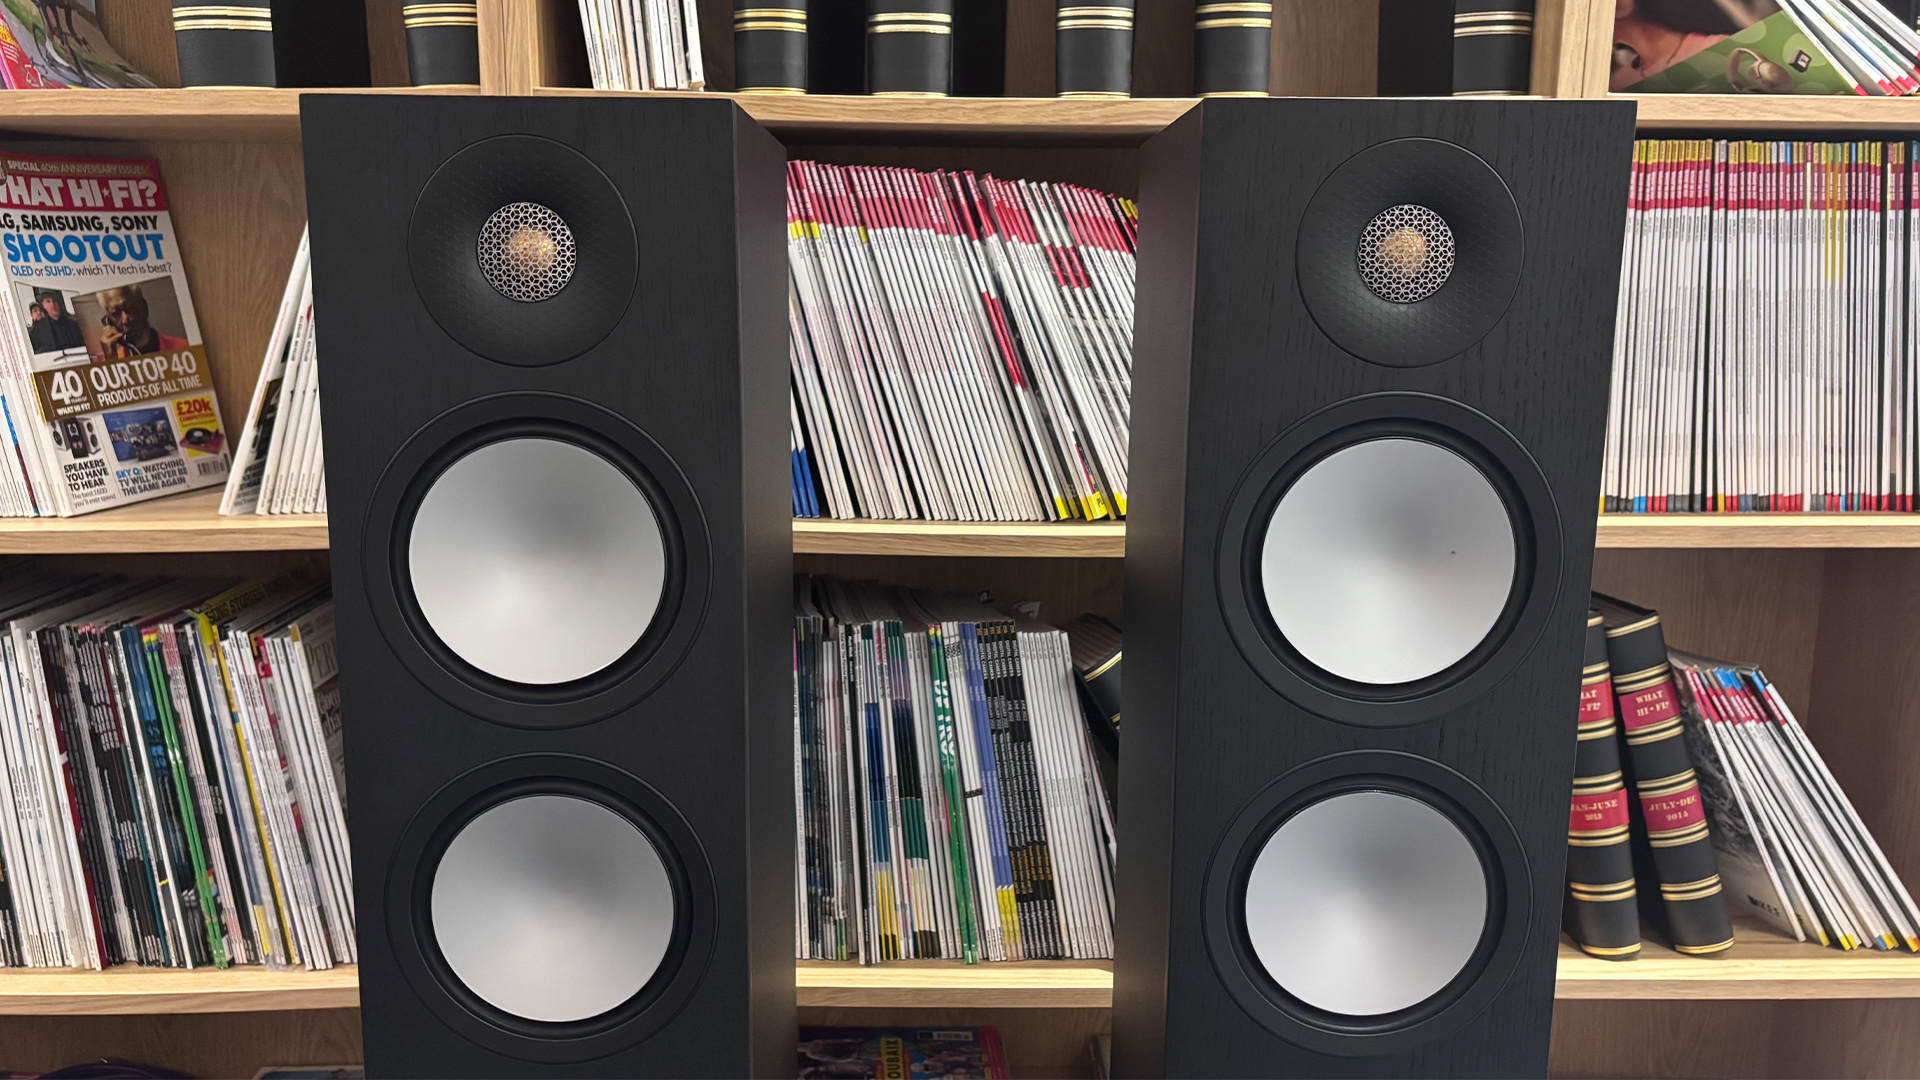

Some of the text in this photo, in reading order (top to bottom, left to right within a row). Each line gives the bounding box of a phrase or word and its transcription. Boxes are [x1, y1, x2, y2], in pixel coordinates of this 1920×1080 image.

[8, 160, 40, 172] SPECIAL
[61, 164, 117, 174] ANNIVERSARY
[21, 214, 109, 233] SAMSUNG,
[110, 215, 158, 230] SONY
[3, 233, 164, 263] SHOOTOUT
[11, 262, 172, 276] OLED or SUHD: which TV tech is best?
[90, 351, 197, 392] OUR TOP 40
[51, 370, 83, 405] 40
[97, 375, 202, 407] PRODUCTS OF ALL TIME
[57, 405, 74, 416] WHAT
[177, 399, 213, 416] £20k
[63, 459, 105, 474] SPEAKERS
[66, 467, 109, 484] YOU HAVE
[116, 468, 132, 479] SKY
[142, 459, 185, 473] WATCHING
[68, 478, 105, 492] TO HEAR
[118, 467, 188, 488] TV WILL NEVER BE
[121, 476, 186, 497] THE SAME AGAIN
[993, 659, 1001, 678] CAMERA
[1006, 657, 1014, 676] CAMERA
[1635, 690, 1664, 704] WHAT
[1649, 795, 1697, 811] JULY-DEC
[886, 1039, 902, 1079] OUBAIX
